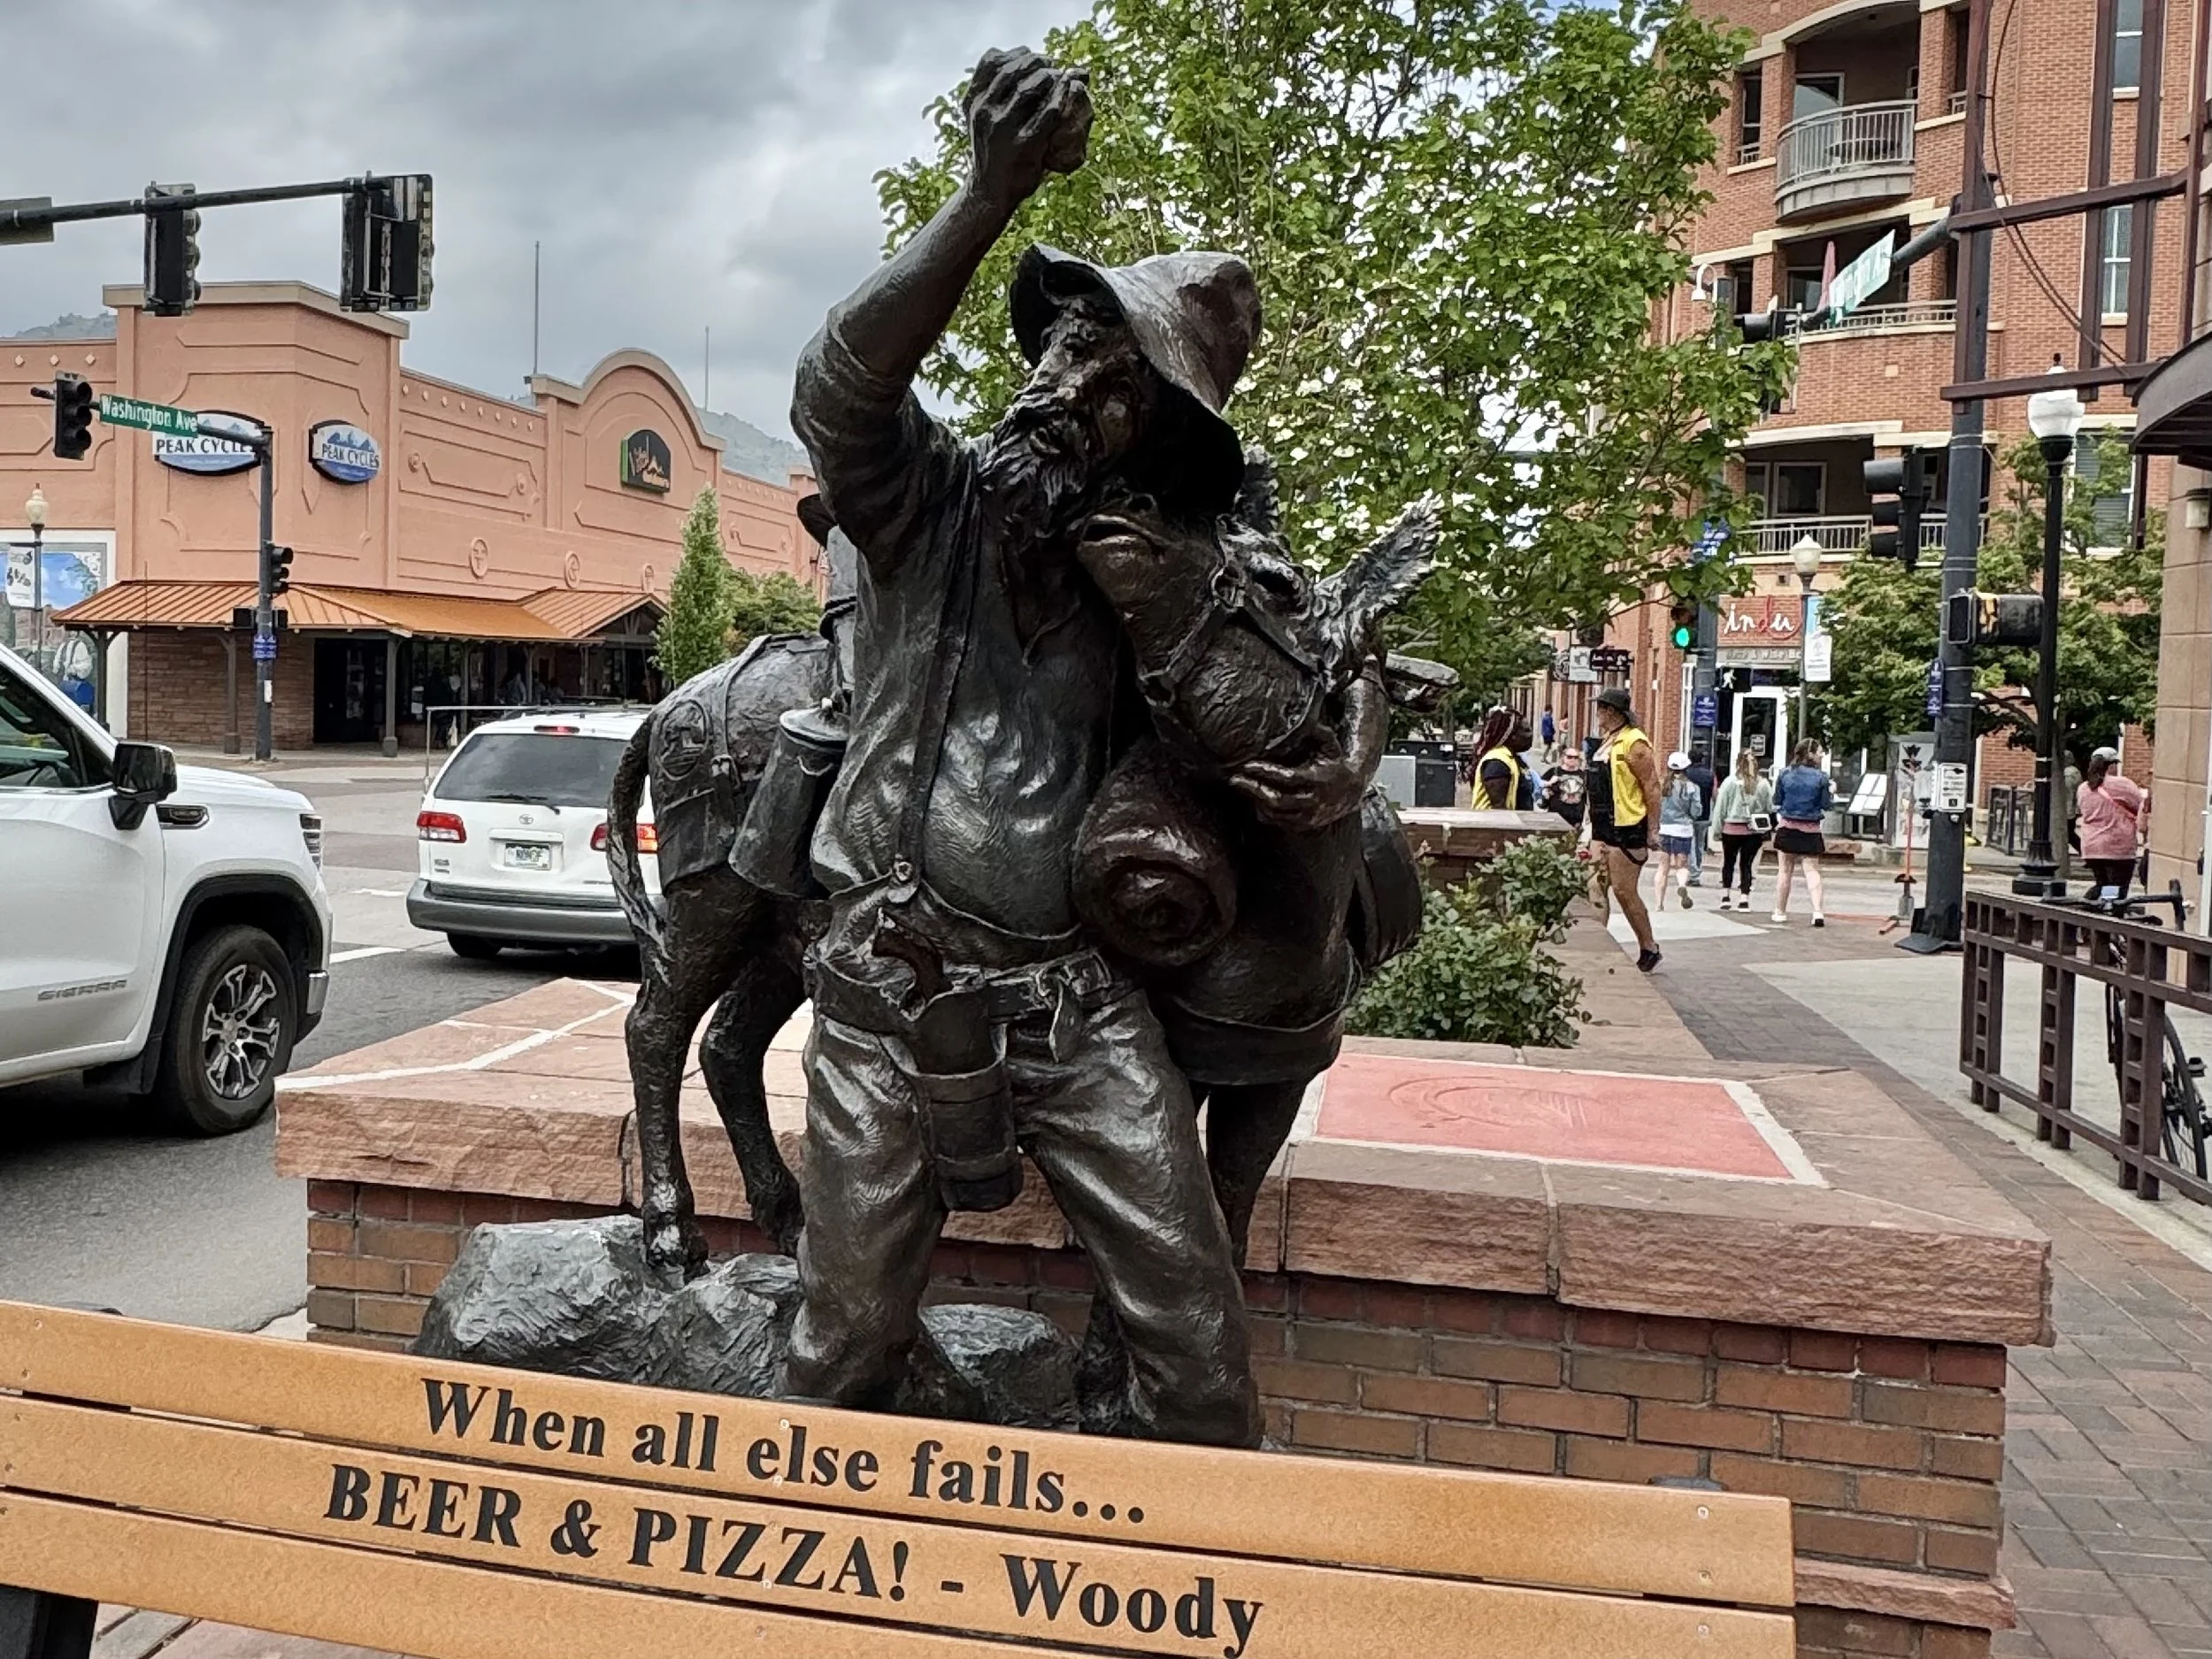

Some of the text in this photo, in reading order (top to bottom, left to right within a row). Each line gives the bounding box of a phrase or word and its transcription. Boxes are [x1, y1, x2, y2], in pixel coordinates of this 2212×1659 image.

[102, 395, 198, 432] Washington Ave
[156, 437, 254, 453] PEAK CYCLE
[321, 443, 380, 469] PEAK CYCLES
[419, 1378, 1145, 1524] When all else fails...
[322, 1463, 1264, 1659] BEER & PIZZA! - Woody
